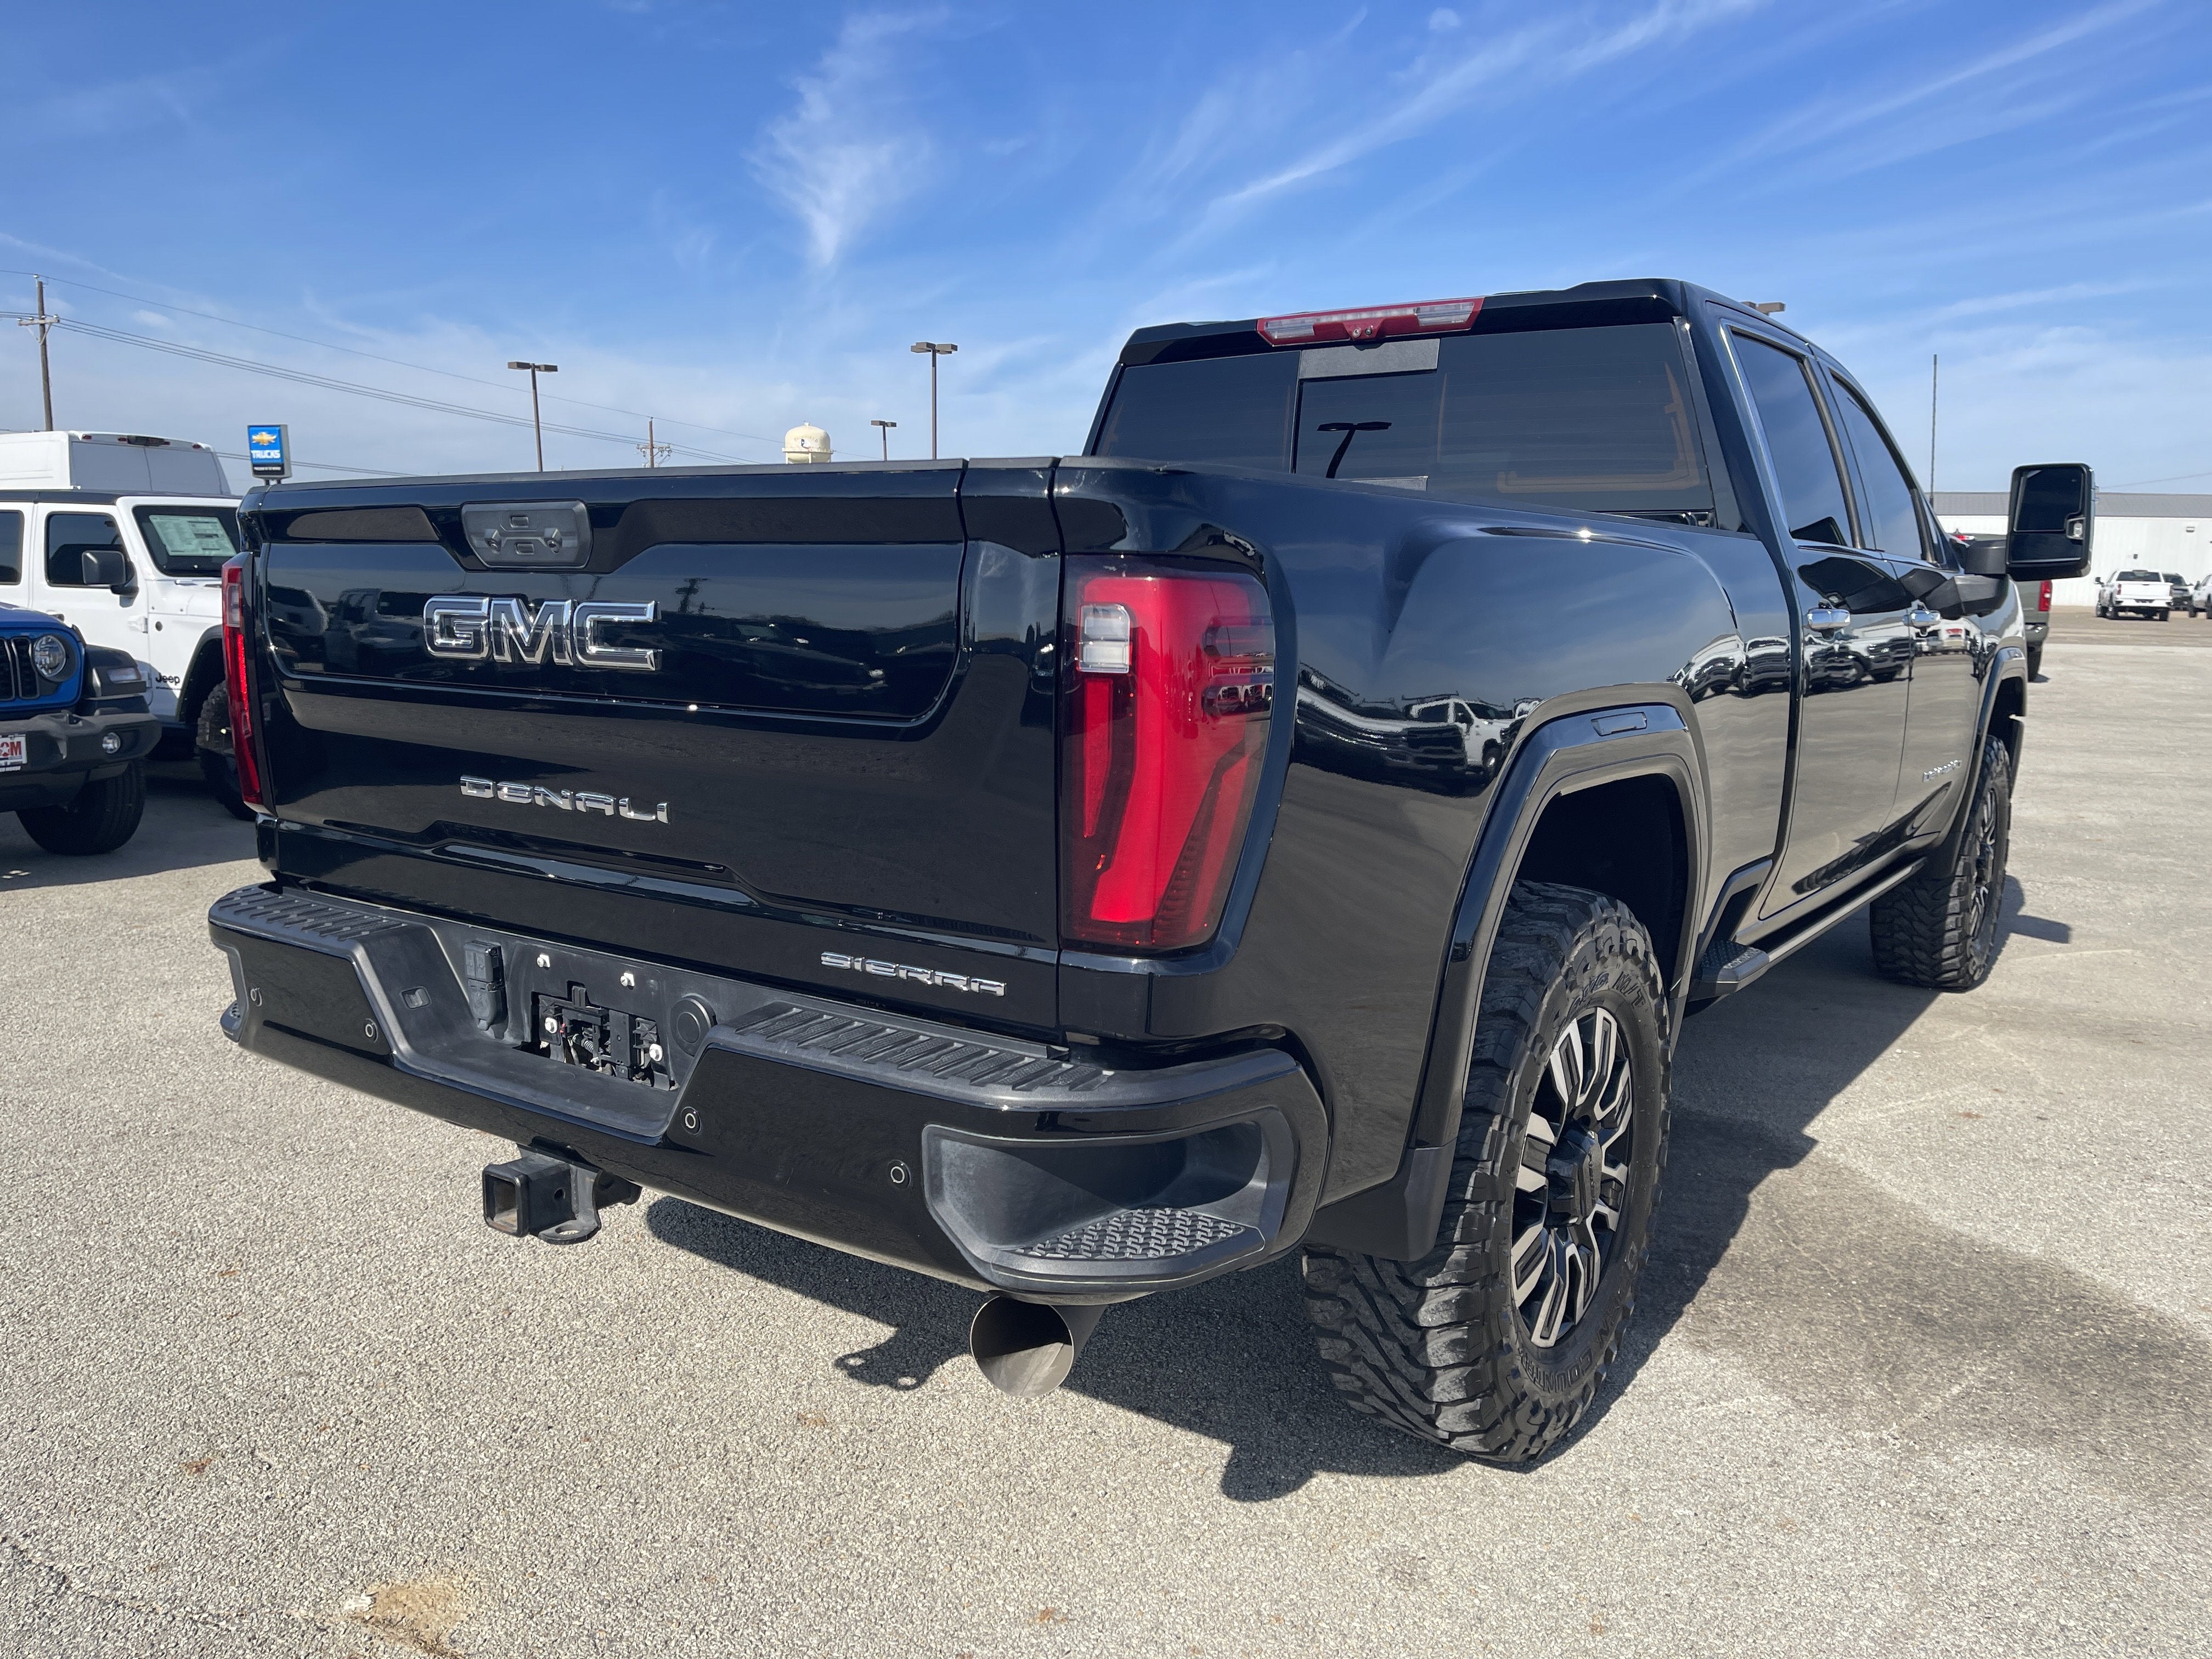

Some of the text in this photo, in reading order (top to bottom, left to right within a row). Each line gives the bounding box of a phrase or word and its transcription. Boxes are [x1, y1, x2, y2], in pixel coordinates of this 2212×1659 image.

[423, 596, 658, 672] GMC
[155, 672, 180, 686] Jeep
[459, 774, 670, 824] DENALI
[821, 951, 1007, 997] SIERRA
